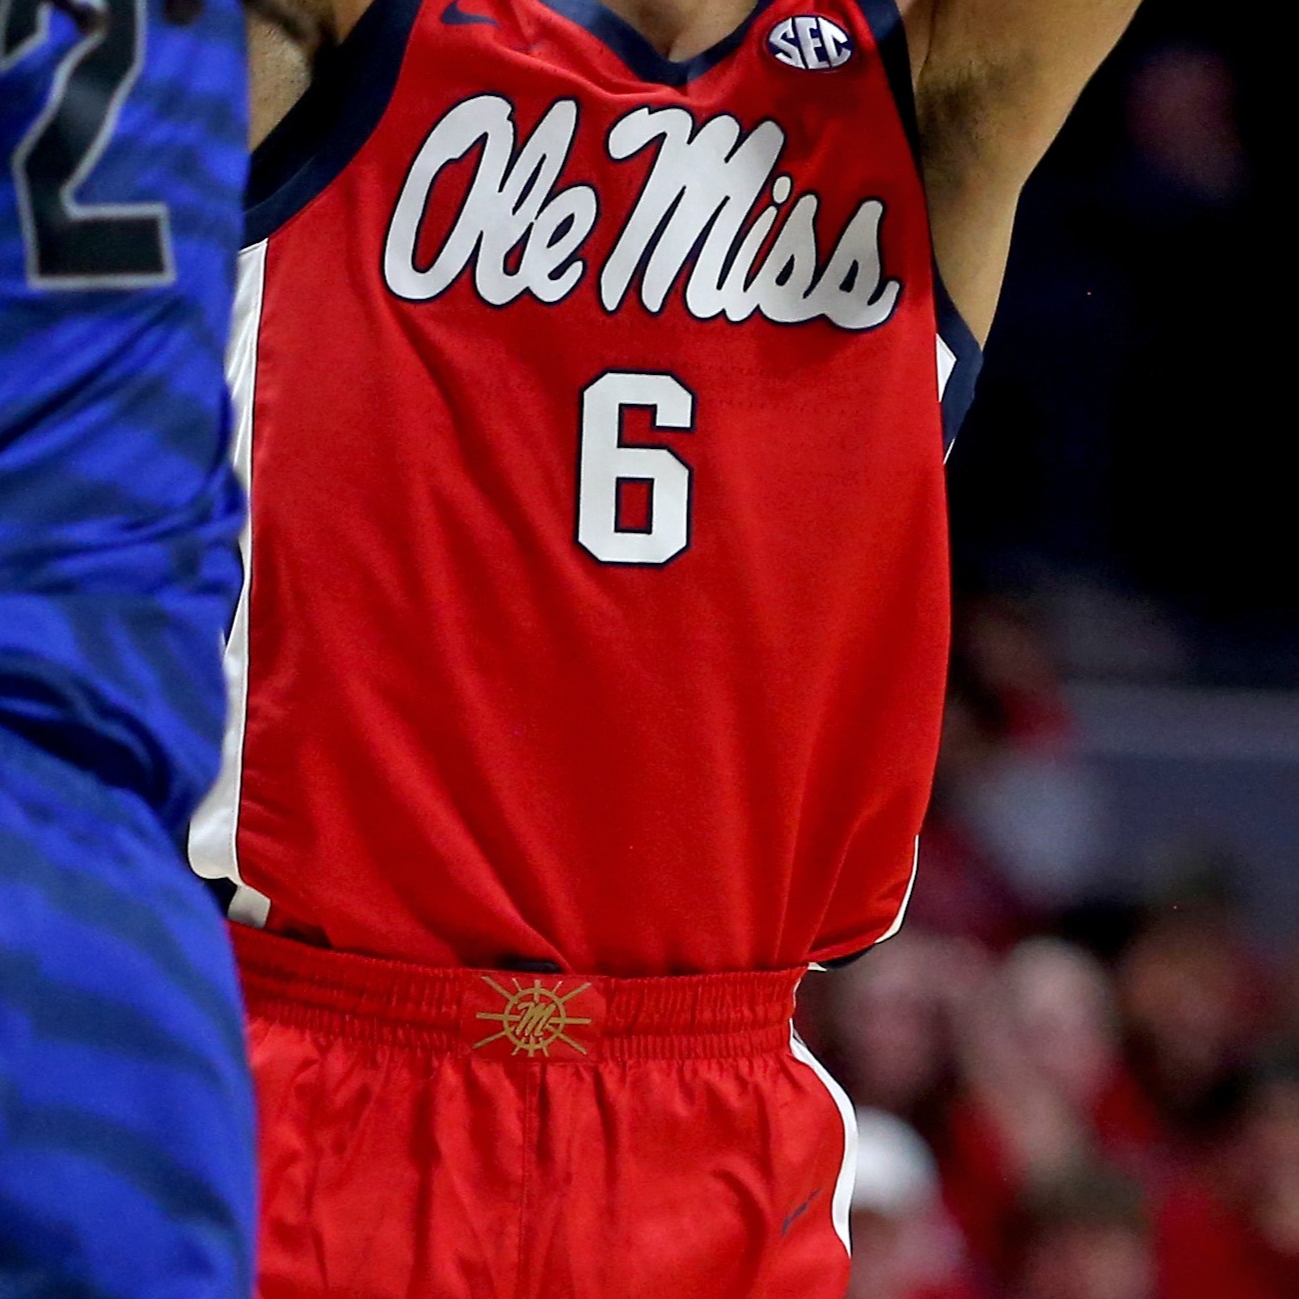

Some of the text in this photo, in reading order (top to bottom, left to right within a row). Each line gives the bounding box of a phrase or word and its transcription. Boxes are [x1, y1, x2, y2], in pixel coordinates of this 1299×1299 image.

[768, 15, 852, 70] SEC
[383, 92, 902, 331] Ole Miss
[576, 370, 695, 566] 6
